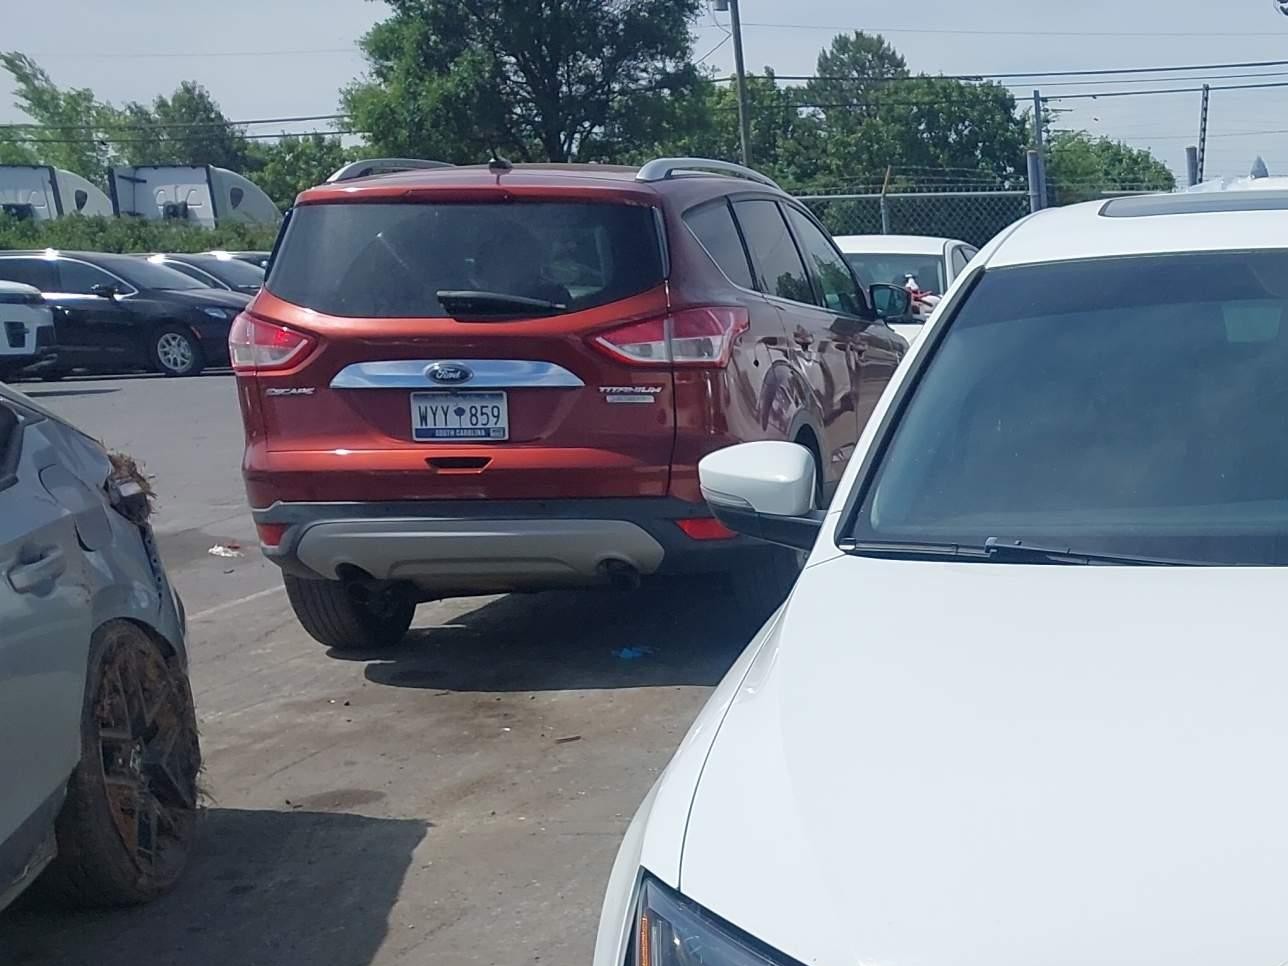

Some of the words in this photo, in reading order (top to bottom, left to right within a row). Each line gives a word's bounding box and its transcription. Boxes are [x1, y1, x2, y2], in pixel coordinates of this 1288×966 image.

[435, 367, 461, 379] Ford
[418, 405, 449, 427] WYY
[469, 405, 500, 426] 859
